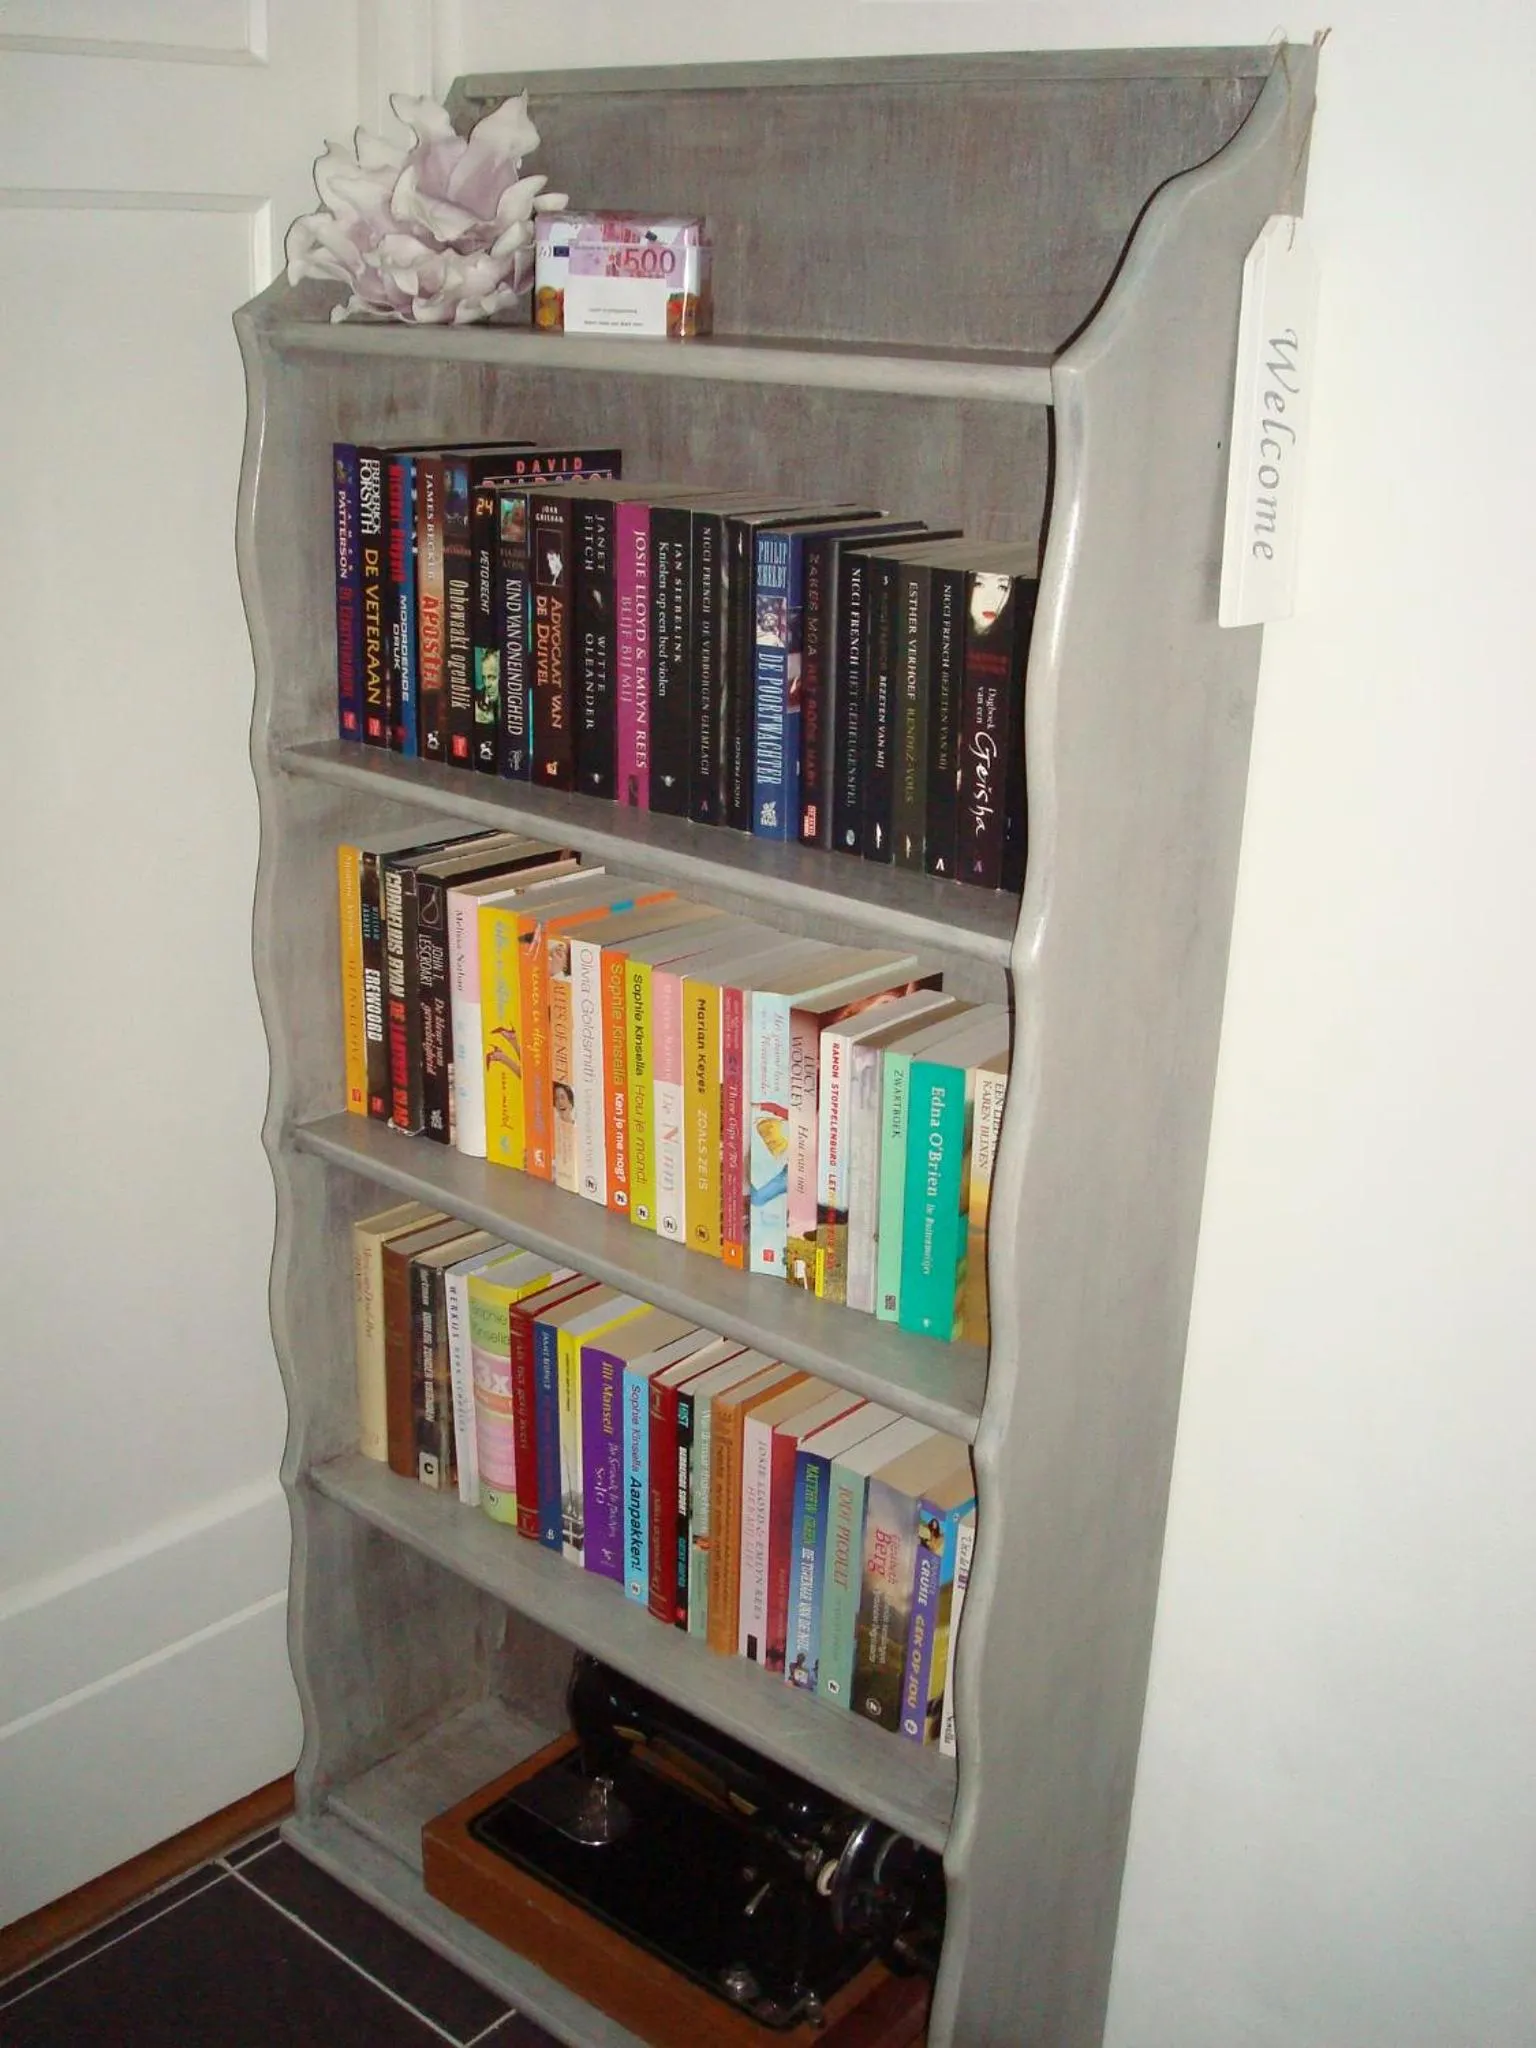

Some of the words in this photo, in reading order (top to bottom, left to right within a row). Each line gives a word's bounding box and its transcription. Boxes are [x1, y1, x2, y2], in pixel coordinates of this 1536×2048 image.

[623, 249, 676, 273] 500
[516, 457, 582, 474] DAVID
[1252, 328, 1300, 560] Welcome
[360, 459, 372, 535] FORSYTH
[371, 460, 381, 536] FREDERICK
[425, 474, 435, 520] JAMES
[476, 497, 494, 516] 24
[339, 490, 347, 579] PATTERSON
[584, 515, 593, 572] FITCH
[594, 515, 605, 571] JANET
[633, 529, 647, 578] JOSIE
[702, 527, 711, 563] NICCI
[365, 548, 379, 578] DE
[658, 541, 669, 589] Knielen
[505, 579, 522, 612] KIND
[536, 595, 547, 616] DE
[656, 592, 666, 610] op
[702, 566, 711, 614] FRENCH
[850, 568, 862, 607] NICCI
[908, 581, 918, 633] ESTHER
[943, 584, 952, 618] NICCI
[449, 580, 470, 649] Onbewaakt
[506, 614, 521, 638] VAN
[620, 595, 632, 640] BLIJF
[635, 584, 646, 641] LLOYD
[366, 581, 380, 704] VETERAAN
[400, 595, 409, 702] MOORDENDE
[537, 623, 549, 686] DUIVEL
[551, 596, 563, 690] ADVOCAAT
[620, 644, 632, 669] BIJ
[636, 646, 646, 659] &
[659, 635, 669, 658] bed
[849, 611, 860, 664] FRENCH
[941, 620, 951, 668] FRENCH
[447, 654, 470, 708] ogenblik
[584, 632, 594, 730] OLEANDER
[597, 636, 605, 693] WITTE
[658, 660, 669, 697] violen
[759, 652, 782, 670] DE
[906, 639, 917, 700] VERHOEF
[506, 640, 523, 735] ONEINDIGHEID
[620, 672, 632, 704] MIJ
[635, 665, 647, 724] EMLYN
[976, 686, 985, 705] van
[984, 687, 997, 730] Dagboek
[551, 694, 562, 729] VAN
[757, 676, 782, 785] POORTWACHTER
[976, 706, 985, 724] een
[636, 730, 646, 768] REES
[876, 748, 885, 768] MIJ
[878, 726, 886, 747] VAN
[969, 732, 997, 838] Geisha
[384, 871, 404, 955] CORNELIUS
[388, 956, 406, 998] RYAN
[418, 933, 433, 988] LESCROART
[432, 944, 444, 972] JOHN
[580, 948, 593, 993] Olivia
[364, 967, 382, 1042] EREWOORD
[609, 963, 625, 1019] Sophie
[632, 974, 643, 1021] Sophie
[580, 999, 595, 1083] Goldsmith
[696, 999, 707, 1050] Marian
[611, 1023, 625, 1085] Kinsella
[634, 1024, 645, 1077] Kinsella
[830, 1042, 840, 1079] RAMON
[695, 1053, 707, 1094] Keyes
[790, 1036, 804, 1112] WOOLLEY
[803, 1055, 815, 1098] LUCY
[615, 1092, 625, 1115] Ken
[634, 1084, 646, 1118] Hou
[728, 1085, 737, 1114] Three
[891, 1069, 904, 1139] ZWARTBOEK
[930, 1086, 945, 1127] Edna
[980, 1080, 993, 1123] KAREN
[612, 1117, 625, 1130] je
[615, 1132, 625, 1151] me
[633, 1121, 646, 1133] je
[697, 1109, 708, 1153] ZOALS
[726, 1116, 737, 1140] Cups
[797, 1125, 809, 1152] Hou
[828, 1083, 839, 1167] STOPPELENBURG
[612, 1152, 626, 1183] nog?
[635, 1136, 647, 1184] mond!
[698, 1157, 707, 1175] ZE
[797, 1154, 807, 1174] van
[926, 1133, 944, 1197] O'Brien
[978, 1125, 991, 1170] BLIXEN
[698, 1177, 708, 1190] IS
[602, 1361, 613, 1382] Jill
[602, 1383, 614, 1436] Mansell
[630, 1384, 641, 1425] Sophie
[631, 1428, 641, 1473] Kinsella
[628, 1476, 642, 1571] Aanpakken!
[838, 1485, 855, 1522] JODI
[754, 1542, 765, 1584] EMLYN
[834, 1525, 850, 1591] PICOULT
[868, 1528, 889, 1578] Berg
[918, 1560, 930, 1606] CRUSIE
[915, 1614, 925, 1648] GEK
[910, 1650, 921, 1672] OP
[907, 1674, 919, 1709] JOU
